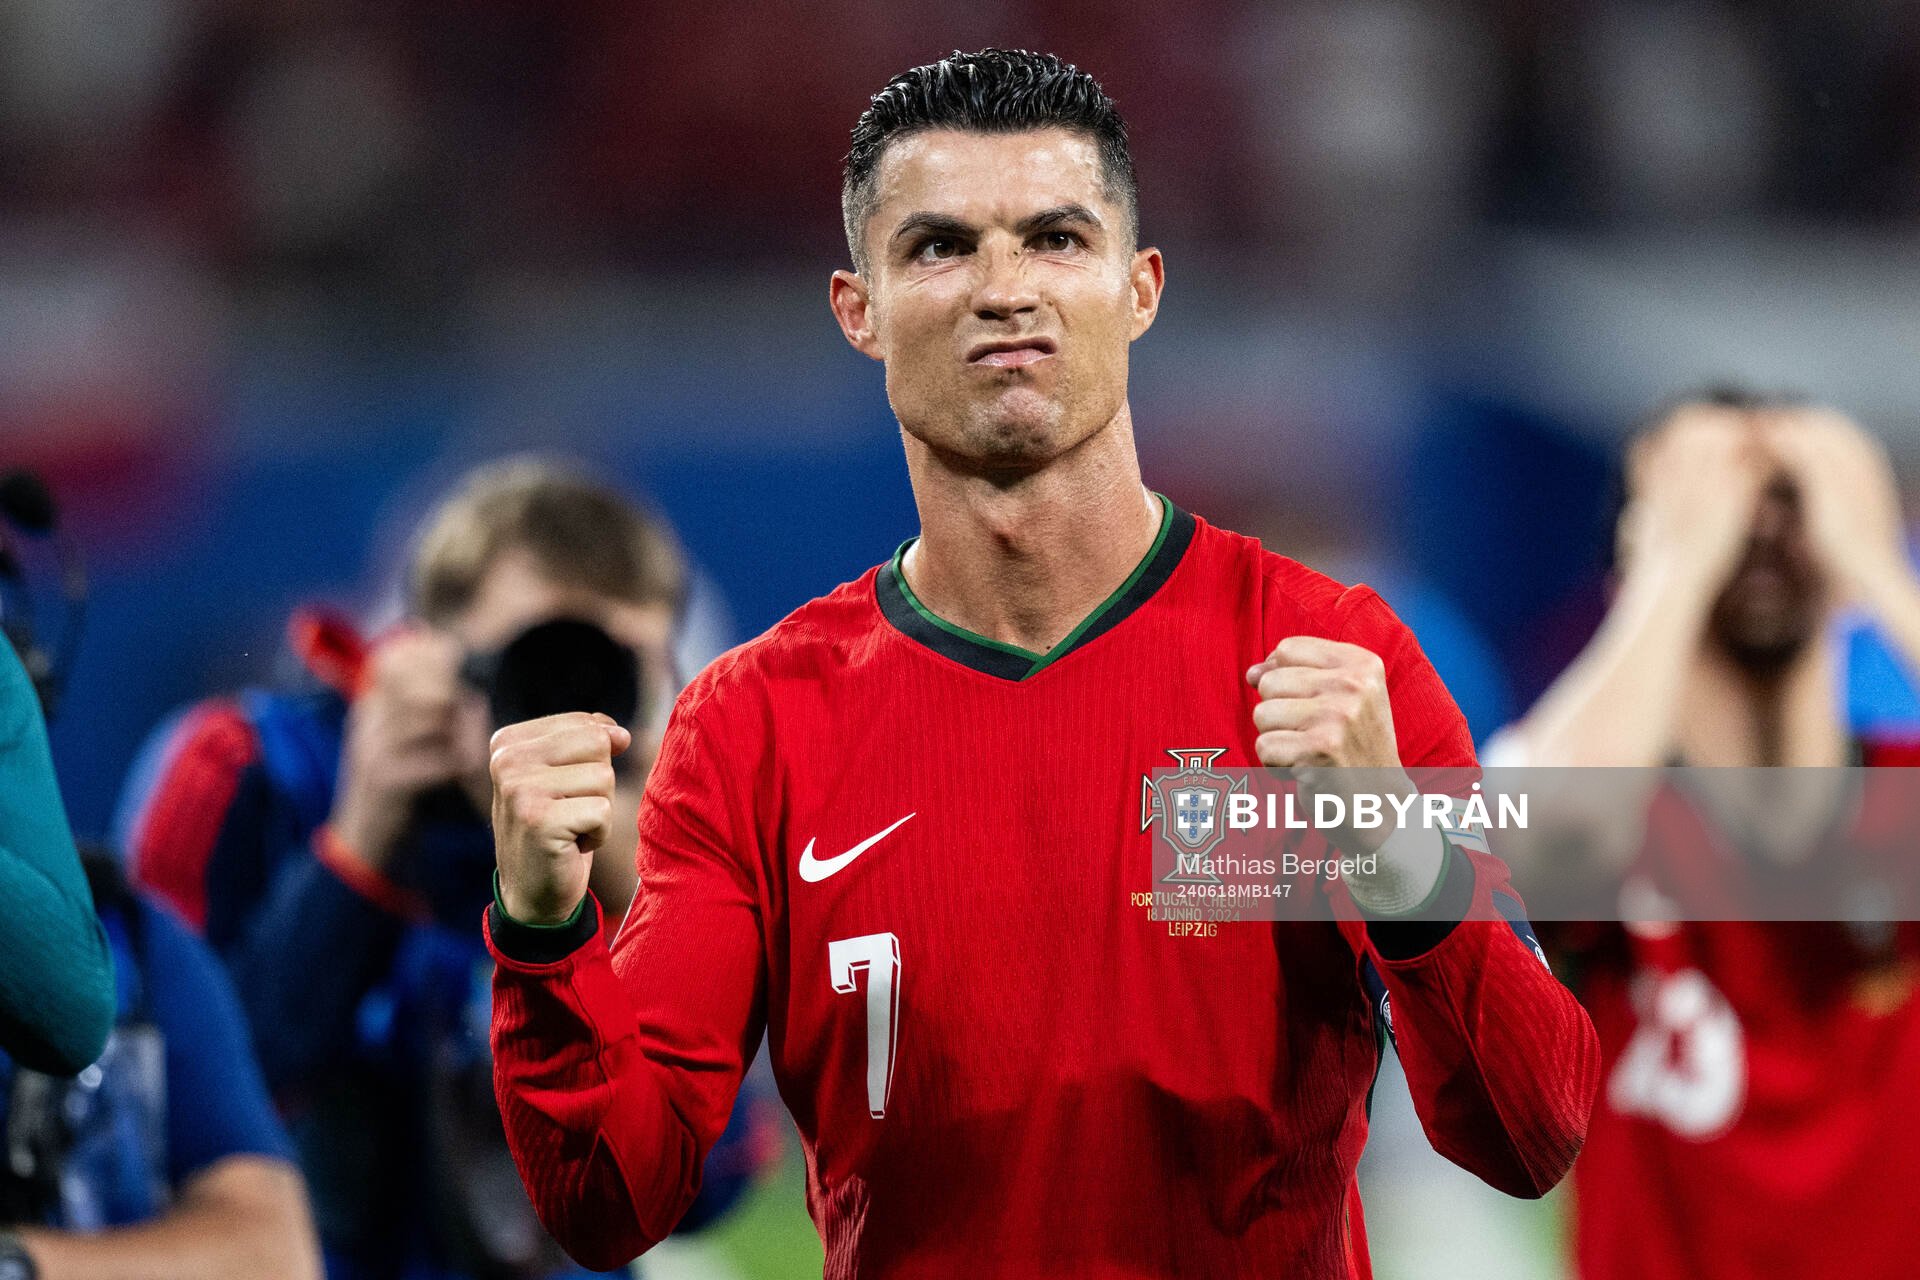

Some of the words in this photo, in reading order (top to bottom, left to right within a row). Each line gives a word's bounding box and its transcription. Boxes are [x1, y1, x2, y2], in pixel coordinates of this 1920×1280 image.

[1147, 907, 1158, 921] 18
[1161, 907, 1202, 921] JUNHO
[1207, 908, 1241, 923] 2024
[1168, 921, 1218, 938] LEIPZIG
[828, 932, 902, 1119] 7
